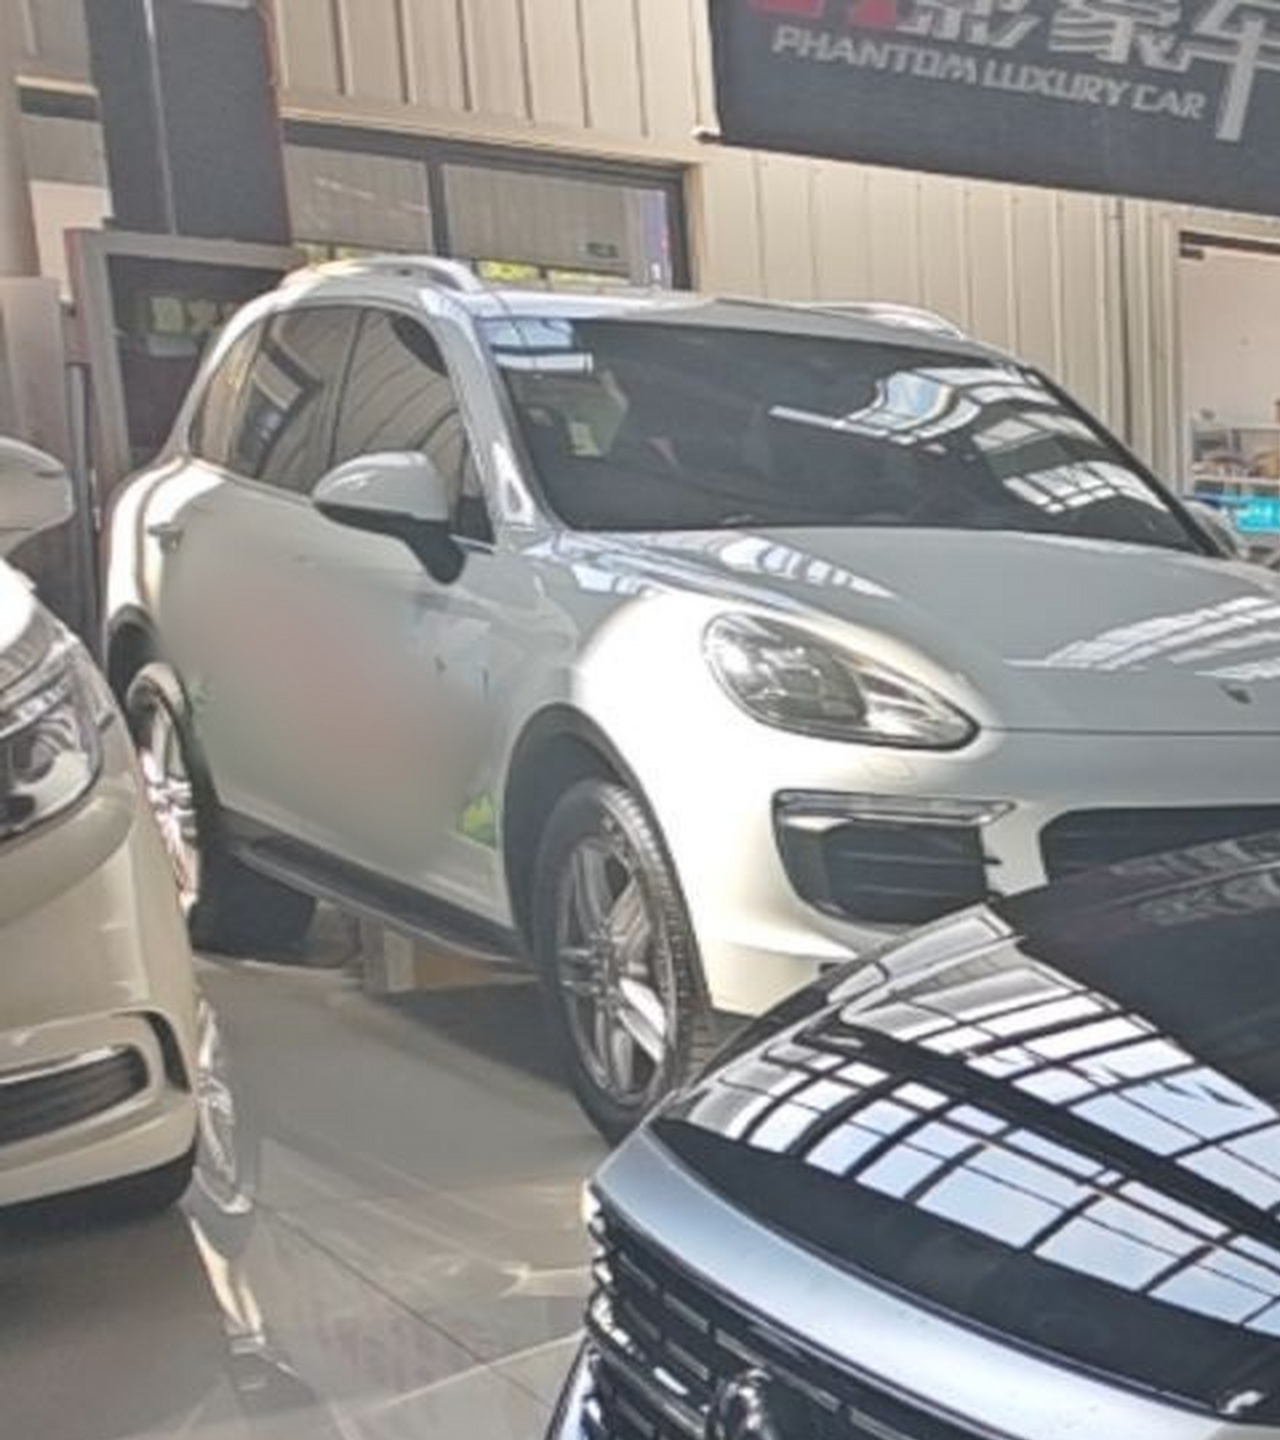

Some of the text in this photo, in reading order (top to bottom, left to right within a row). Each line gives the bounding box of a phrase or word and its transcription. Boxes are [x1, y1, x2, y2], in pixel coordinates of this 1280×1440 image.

[771, 24, 1207, 120] PHANTOM LUXURY CAR
